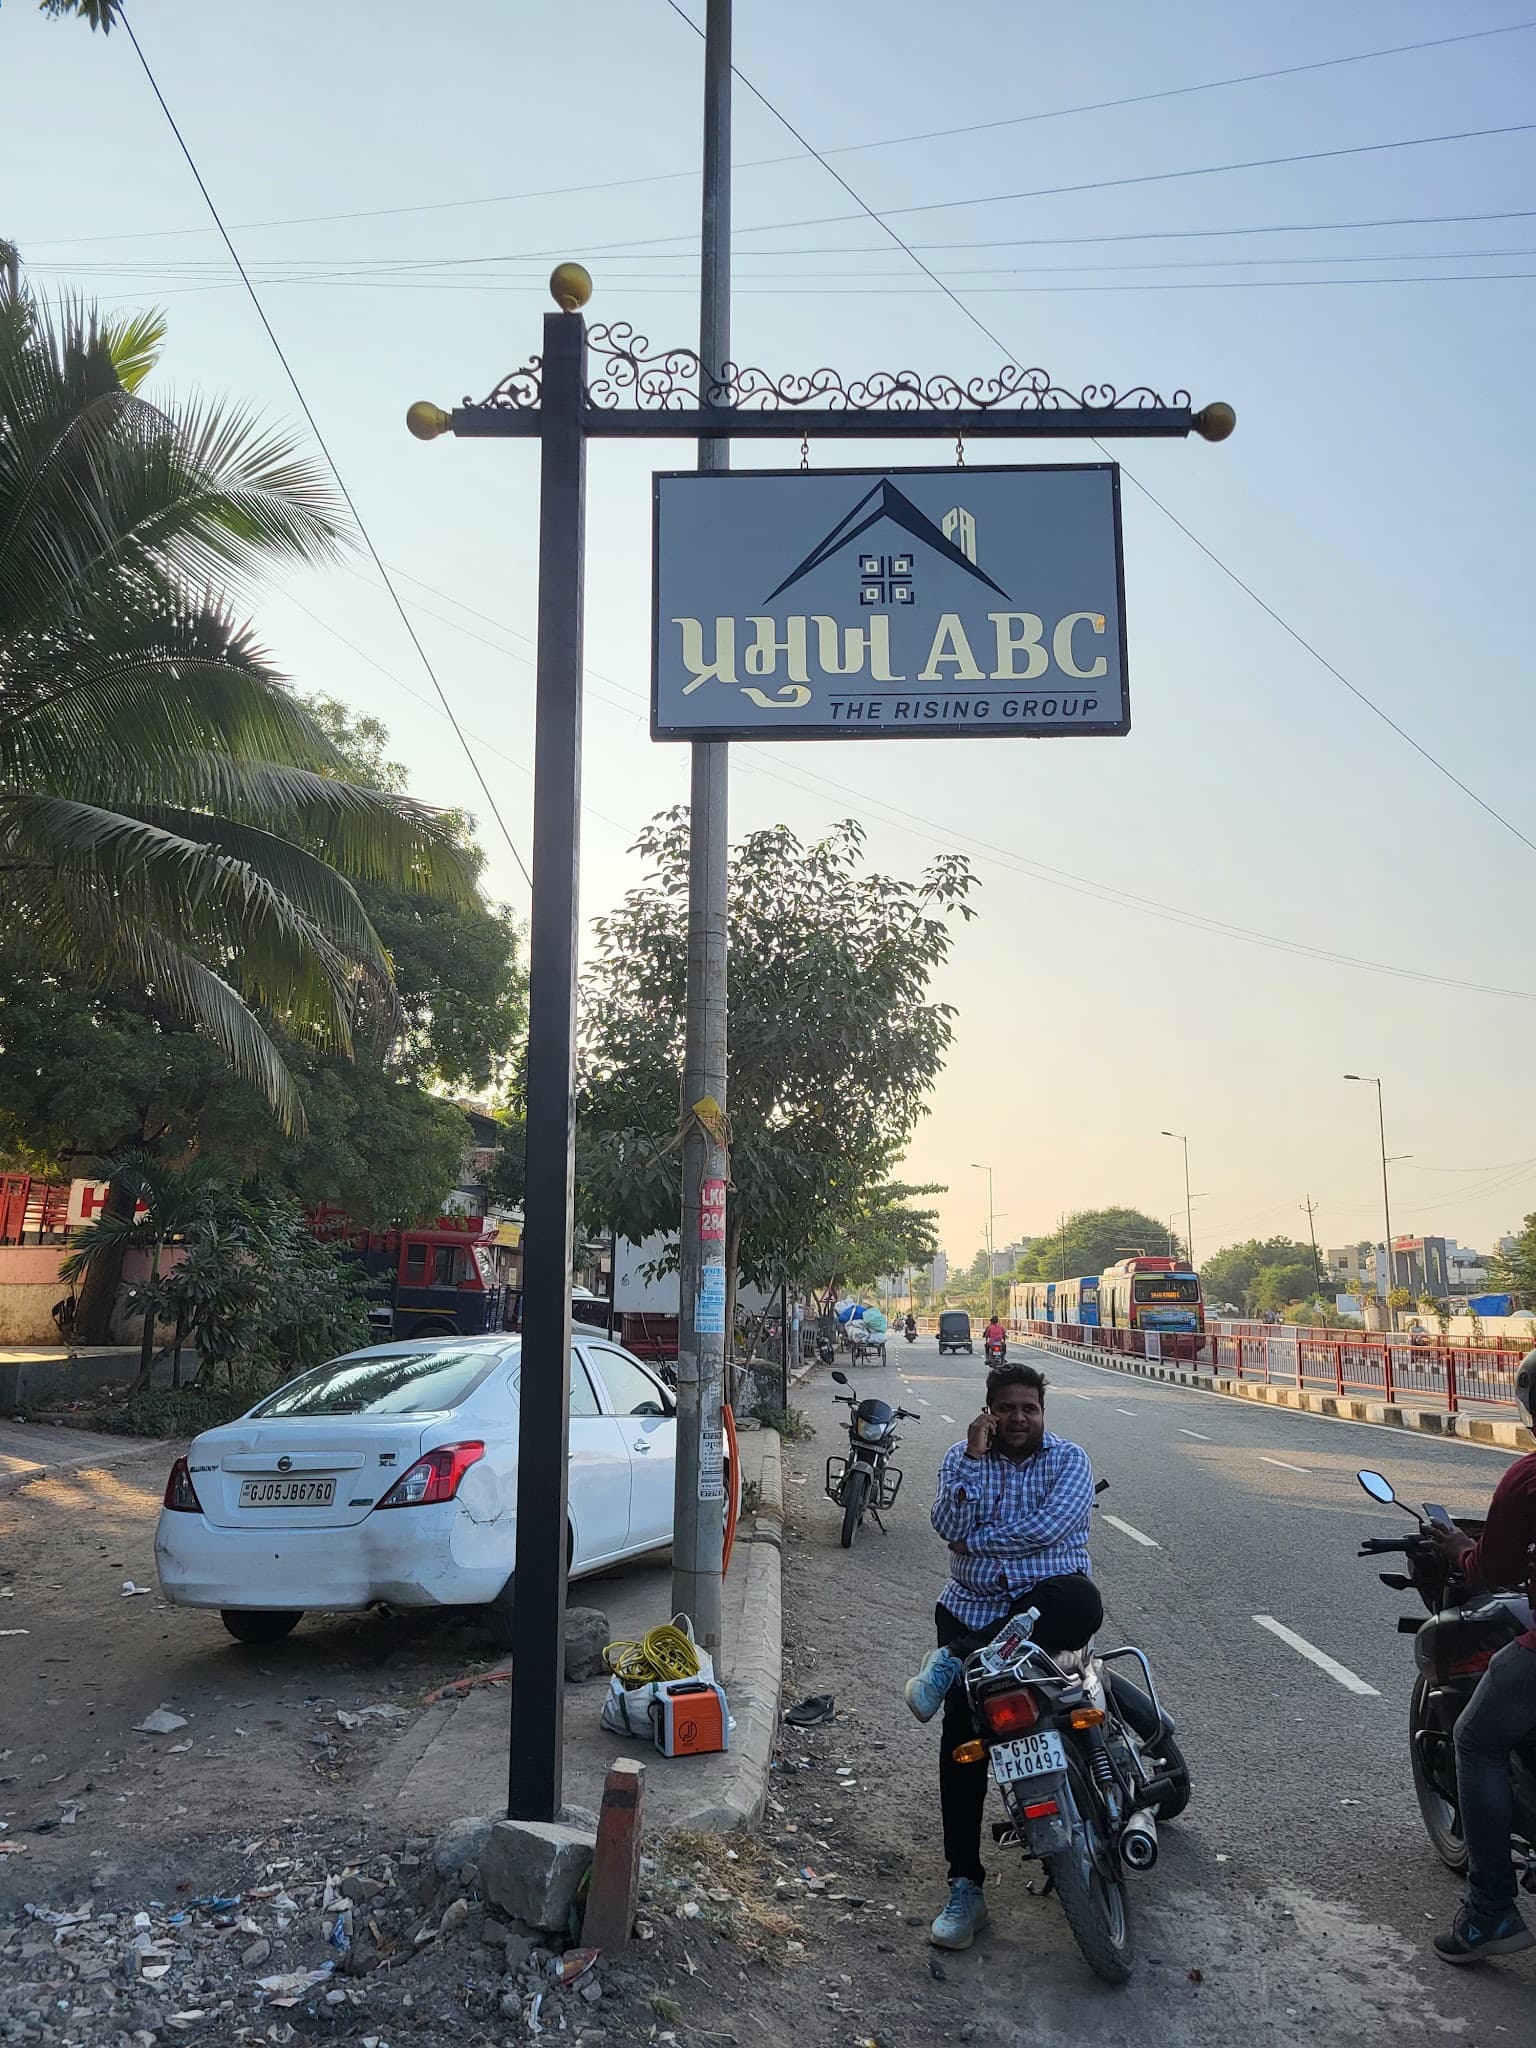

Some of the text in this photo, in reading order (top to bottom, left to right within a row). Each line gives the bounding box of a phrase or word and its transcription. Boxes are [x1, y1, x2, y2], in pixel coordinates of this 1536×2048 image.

[671, 611, 1108, 708] પ્રમુખ ABC
[829, 699, 1099, 720] THE RISING GROUP
[250, 1483, 332, 1501] GJ05JB6760
[1011, 1734, 1049, 1758] GJ05
[1004, 1750, 1064, 1779] FK0492
